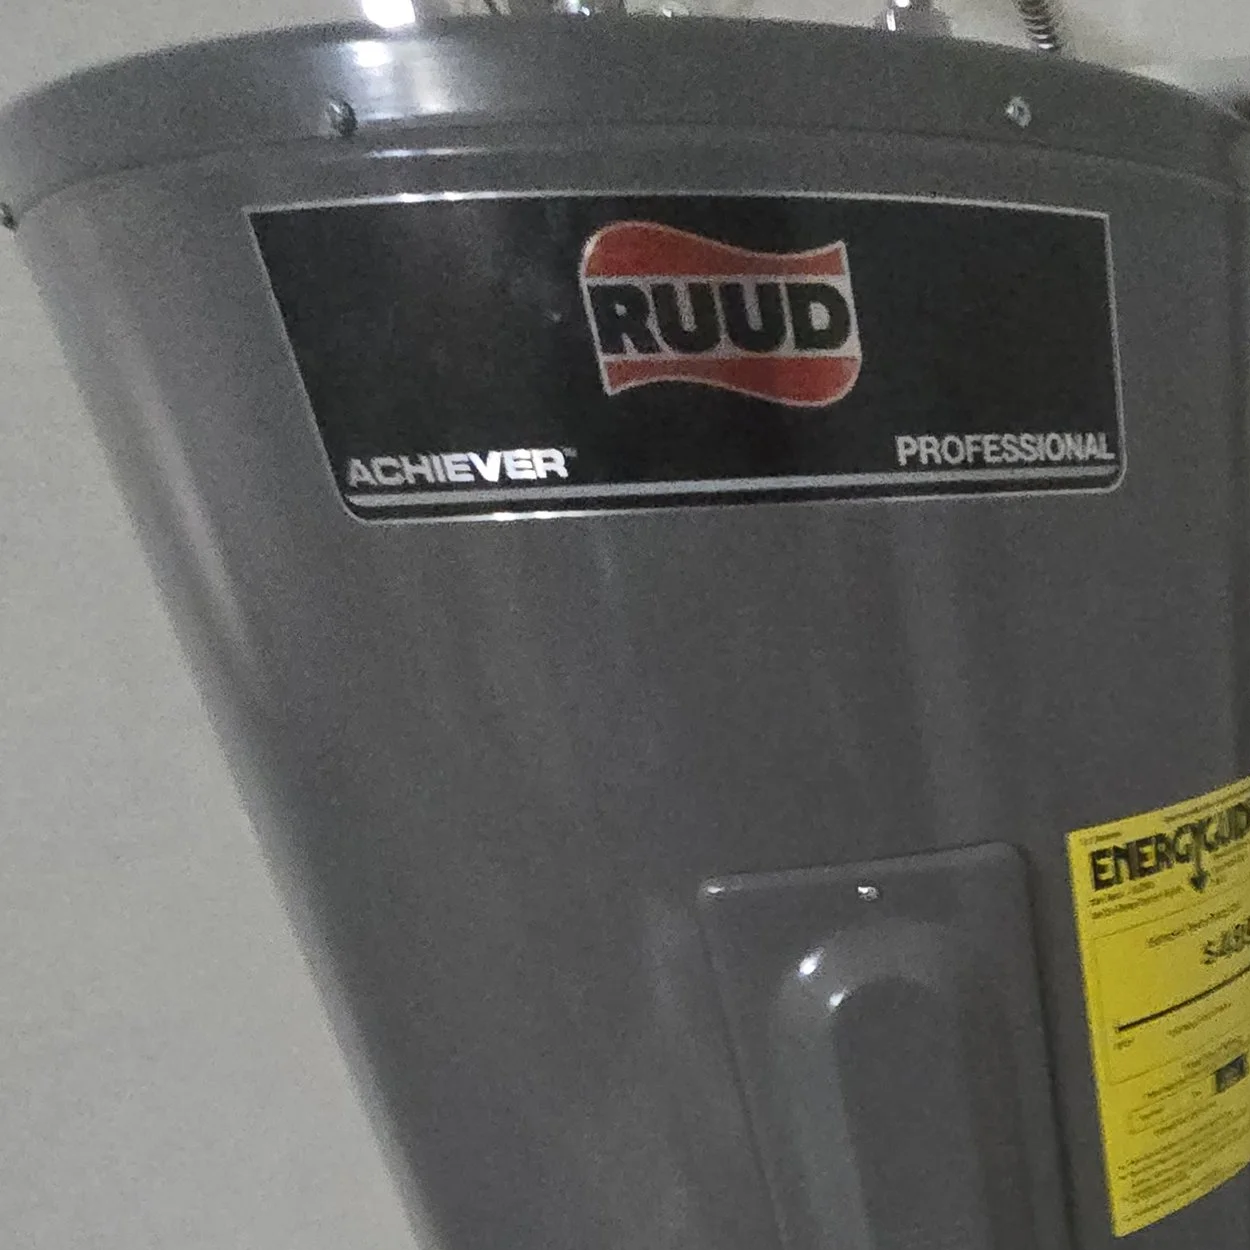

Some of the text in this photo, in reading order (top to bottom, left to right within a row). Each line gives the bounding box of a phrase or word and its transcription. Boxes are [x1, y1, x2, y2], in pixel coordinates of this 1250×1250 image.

[590, 282, 852, 356] RUUD
[347, 448, 569, 488] ACHIEVER
[895, 432, 1115, 466] PROFESSIONAL
